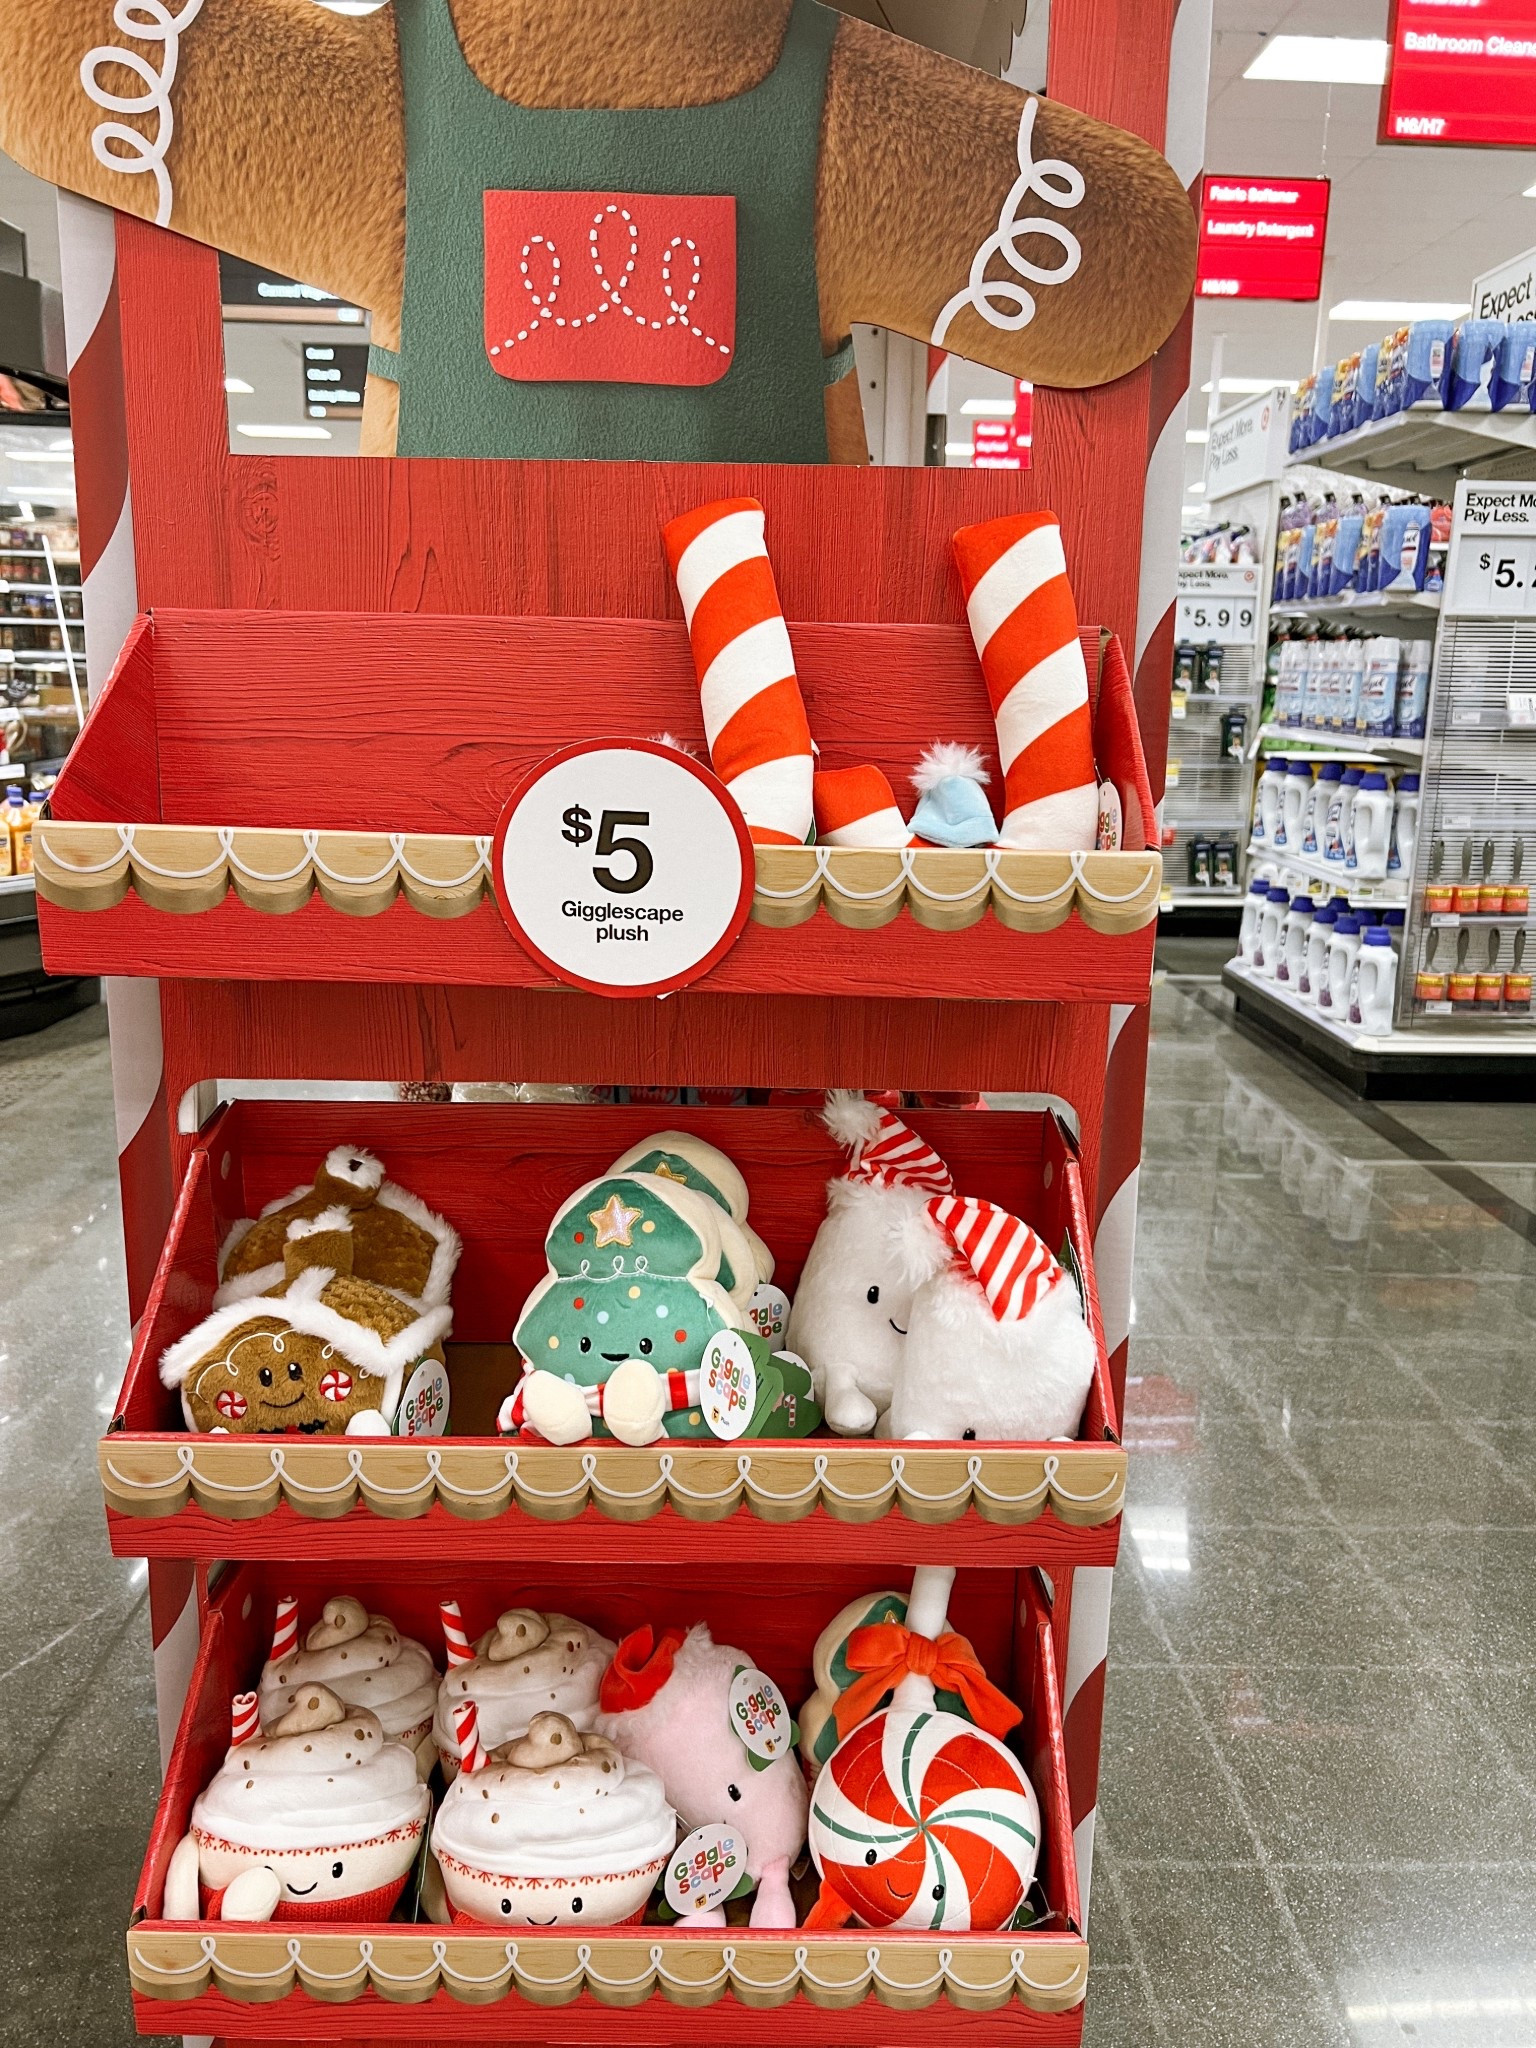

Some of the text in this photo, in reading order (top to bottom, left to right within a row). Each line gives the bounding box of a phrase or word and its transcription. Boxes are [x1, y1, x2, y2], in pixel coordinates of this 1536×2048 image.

[1404, 31, 1484, 54] Bathroom
[1209, 185, 1299, 204] Fabric Softener
[1207, 219, 1314, 240] Laundry Detergent
[1480, 272, 1532, 319] Expect
[1466, 493, 1515, 509] Expect
[1464, 508, 1529, 524] Pay Less.
[1178, 570, 1203, 579] xpect
[561, 803, 654, 894] $5
[561, 900, 684, 924] Gigglescape
[596, 925, 649, 943] plush
[674, 1837, 734, 1880] Giggle
